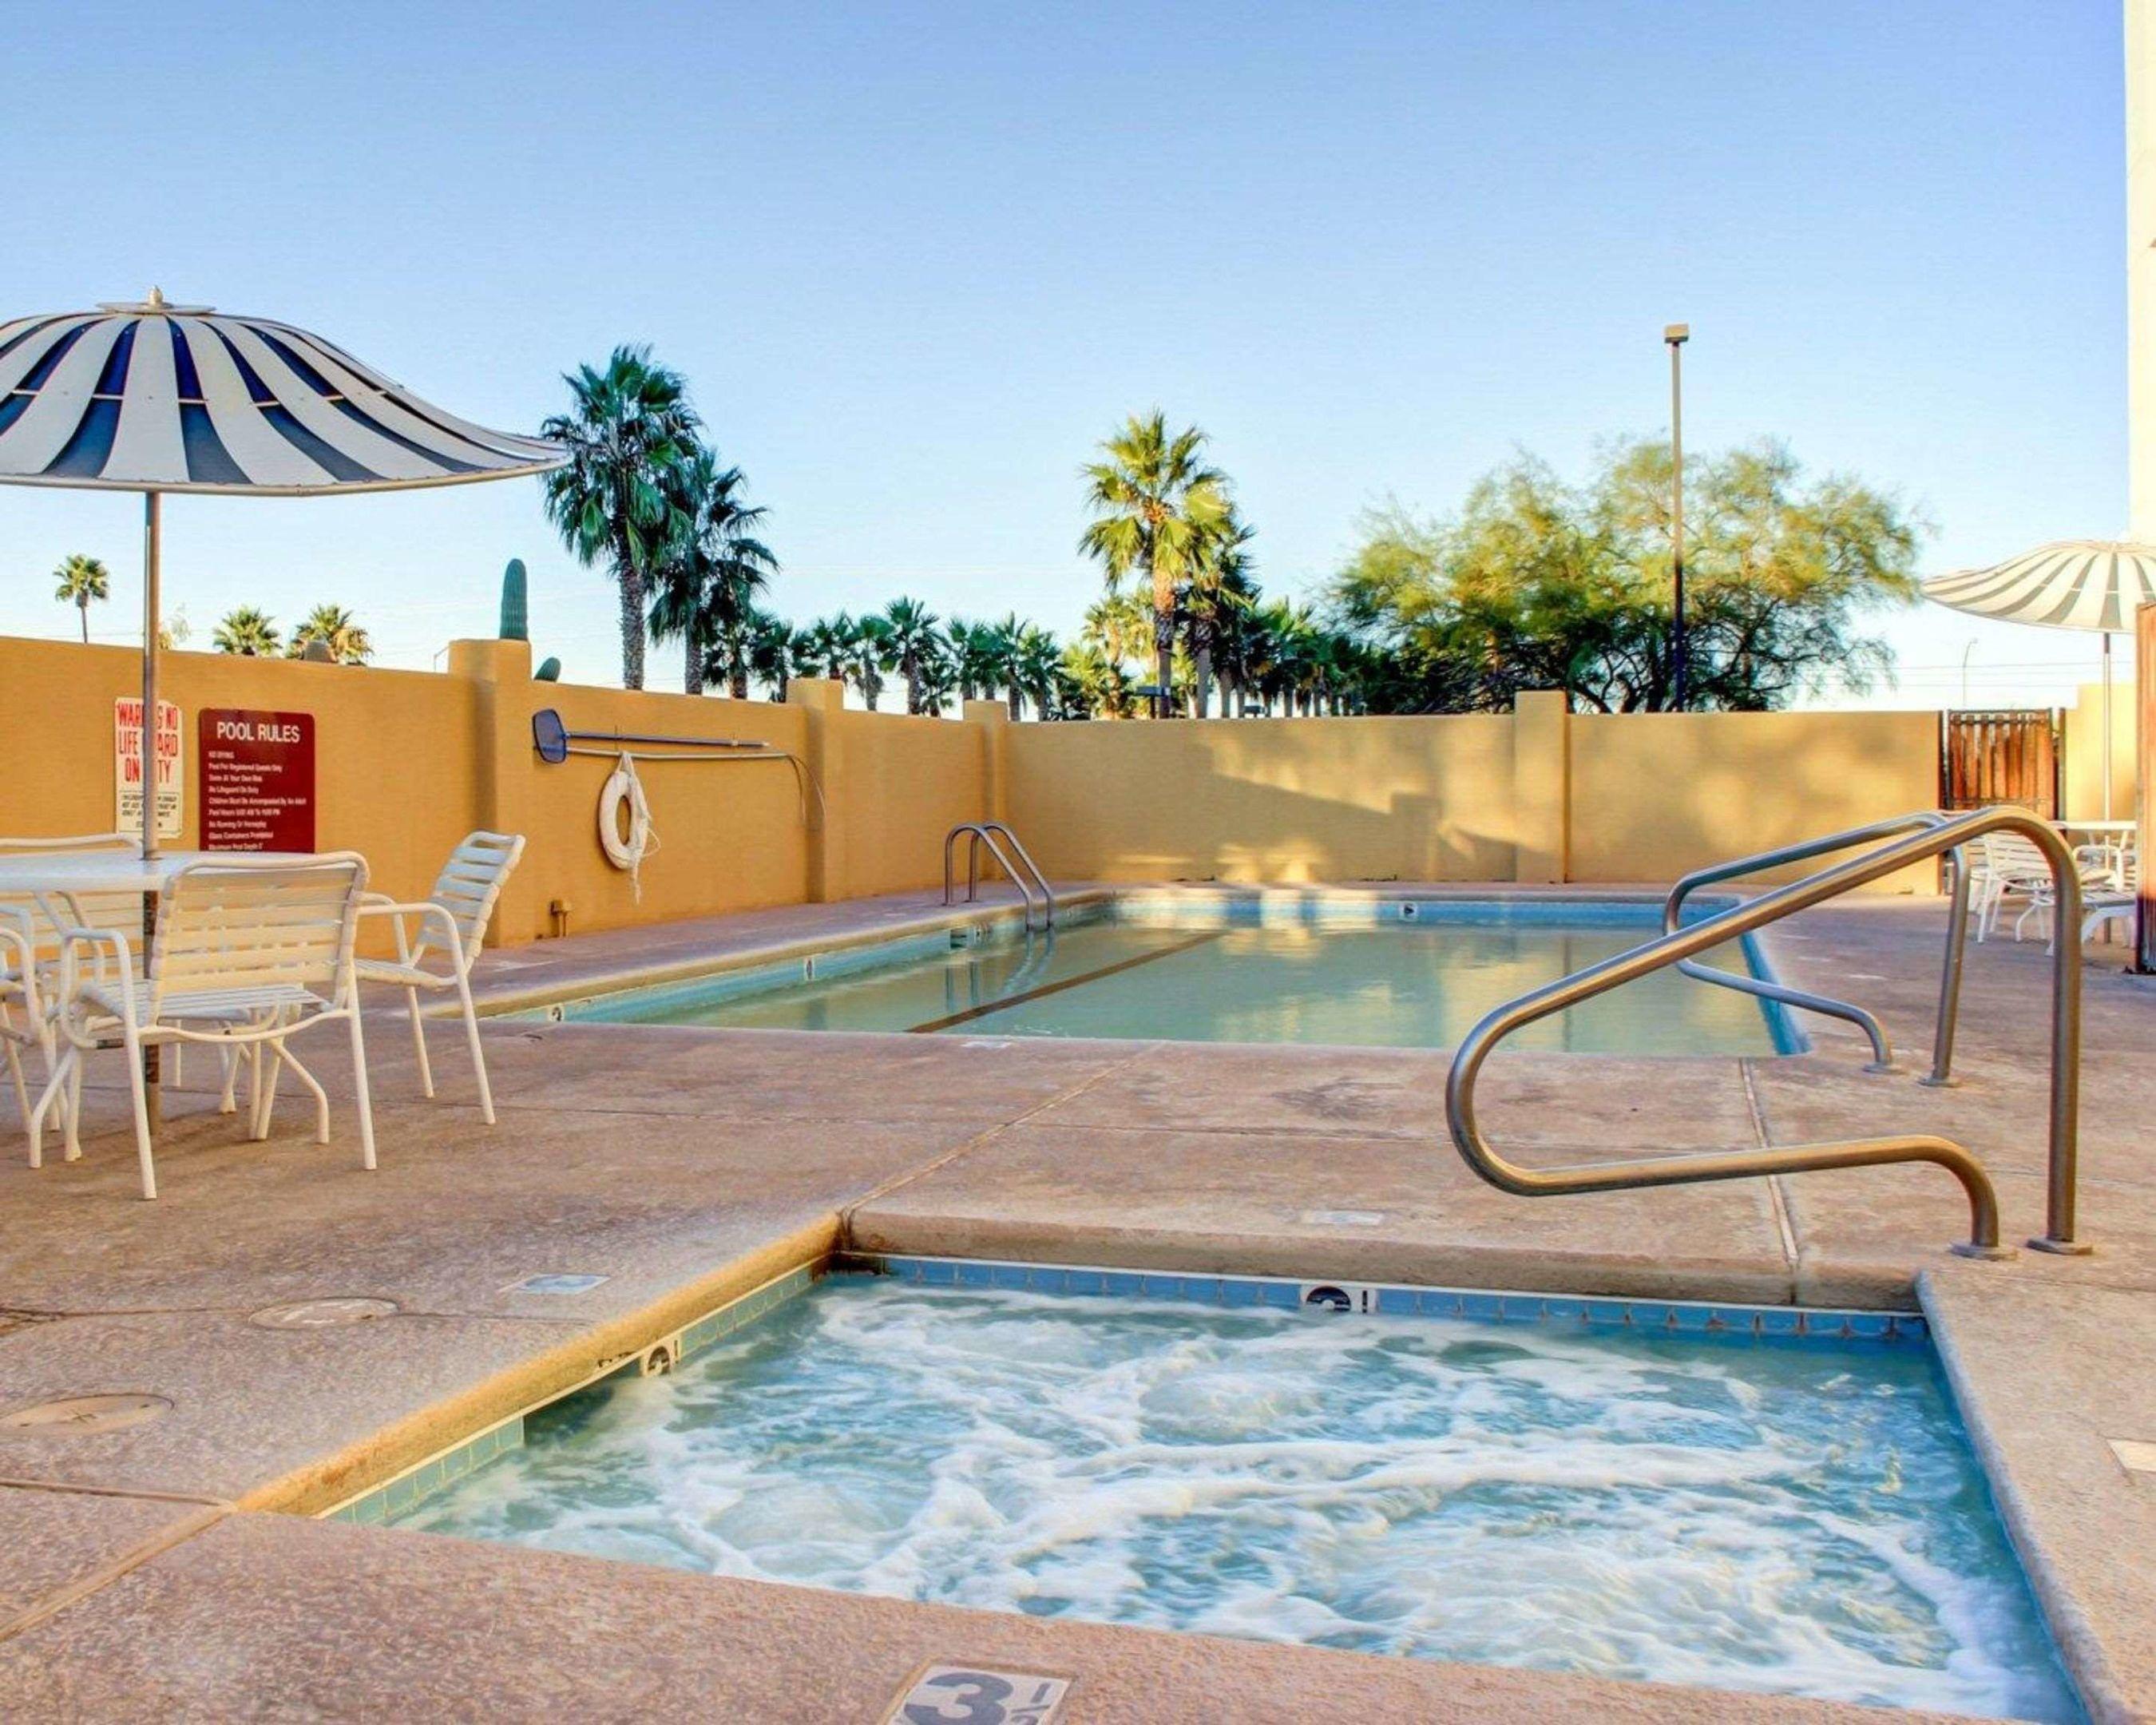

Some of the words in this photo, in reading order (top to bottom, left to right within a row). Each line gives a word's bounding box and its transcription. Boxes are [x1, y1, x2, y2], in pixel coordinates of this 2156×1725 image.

[117, 703, 164, 730] WARG
[166, 707, 178, 731] NO
[119, 730, 137, 755] LIFE
[216, 721, 255, 741] POOL
[257, 723, 301, 744] RULES
[125, 757, 141, 783] ON
